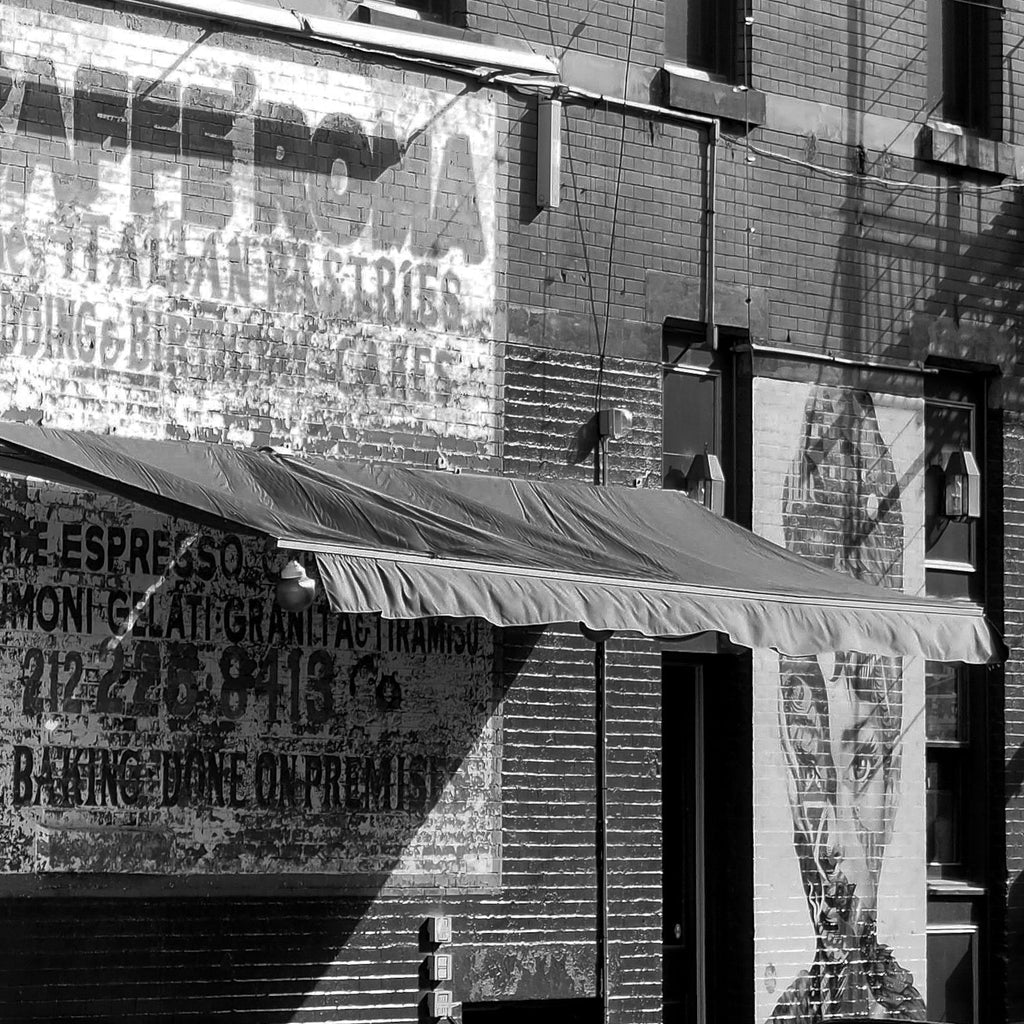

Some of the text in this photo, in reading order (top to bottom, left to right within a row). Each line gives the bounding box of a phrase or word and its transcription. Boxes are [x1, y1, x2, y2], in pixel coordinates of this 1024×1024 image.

[254, 100, 486, 265] ROMA
[62, 524, 244, 580] ESPRESSO
[12, 745, 139, 807] BAKING
[162, 749, 246, 808] DONE
[255, 751, 296, 808] ON
